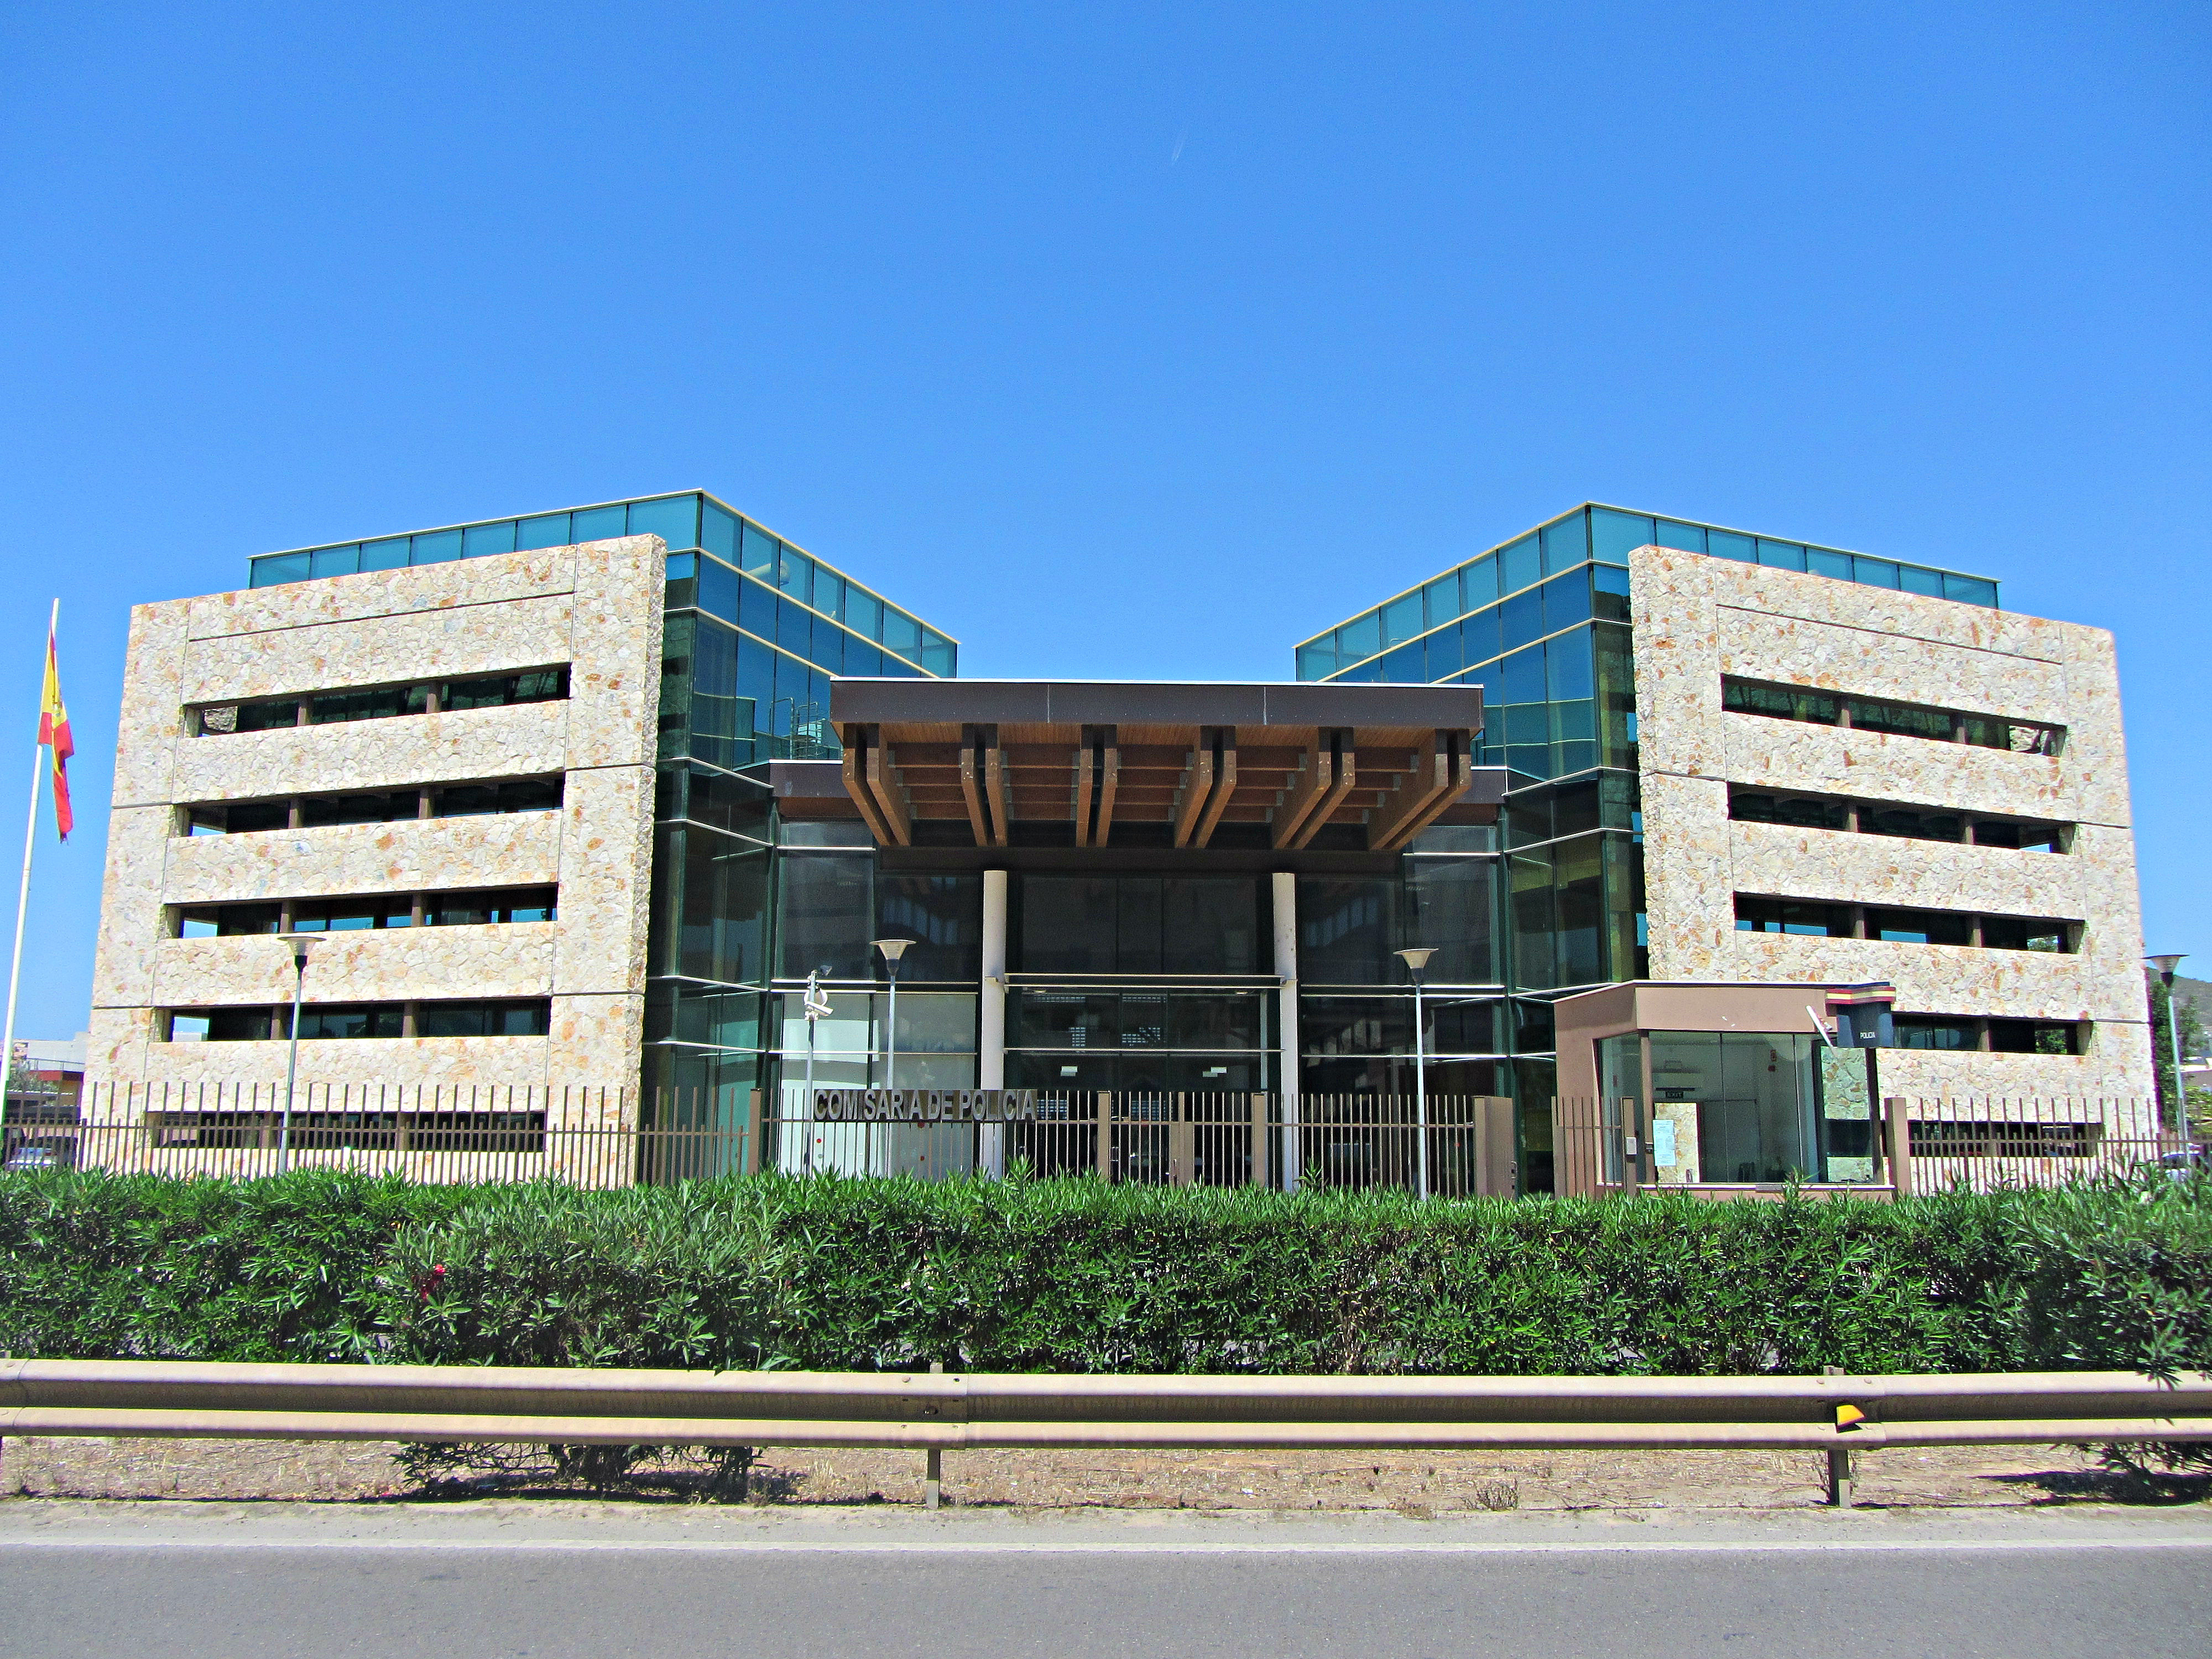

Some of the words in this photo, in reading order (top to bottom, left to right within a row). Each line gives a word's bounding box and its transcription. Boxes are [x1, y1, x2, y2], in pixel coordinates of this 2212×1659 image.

[814, 1089, 923, 1120] COMISARIA
[928, 1090, 953, 1120] DE
[959, 1089, 1036, 1120] POLICIA
